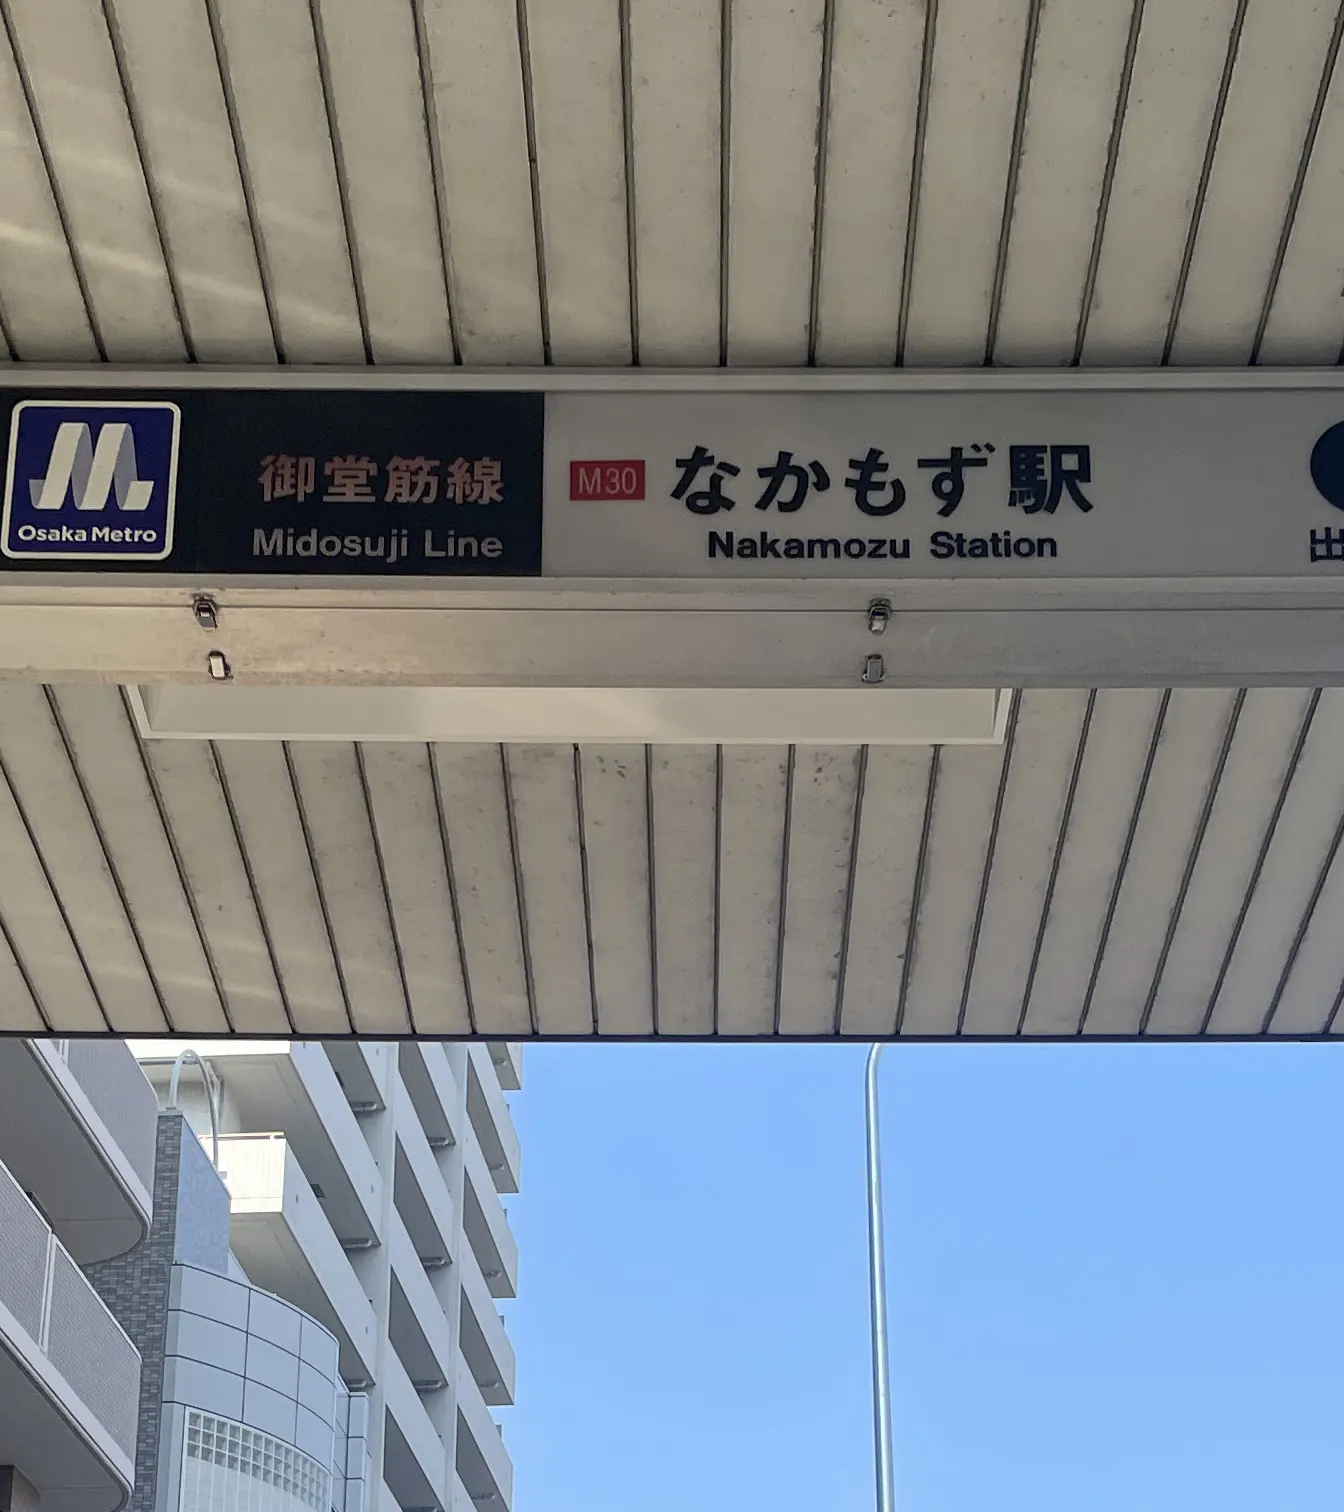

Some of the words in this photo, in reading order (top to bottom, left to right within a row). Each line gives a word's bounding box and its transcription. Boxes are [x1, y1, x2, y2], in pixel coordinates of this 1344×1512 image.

[257, 453, 505, 507] 御堂筋線
[577, 466, 639, 496] M30
[670, 442, 1095, 518] なかもず駅
[17, 523, 88, 545] Osaka
[90, 523, 157, 545] Metro
[252, 527, 409, 565] Midosuji
[423, 527, 504, 560] Line
[708, 530, 911, 560] Nakamozu
[929, 529, 1058, 560] Station
